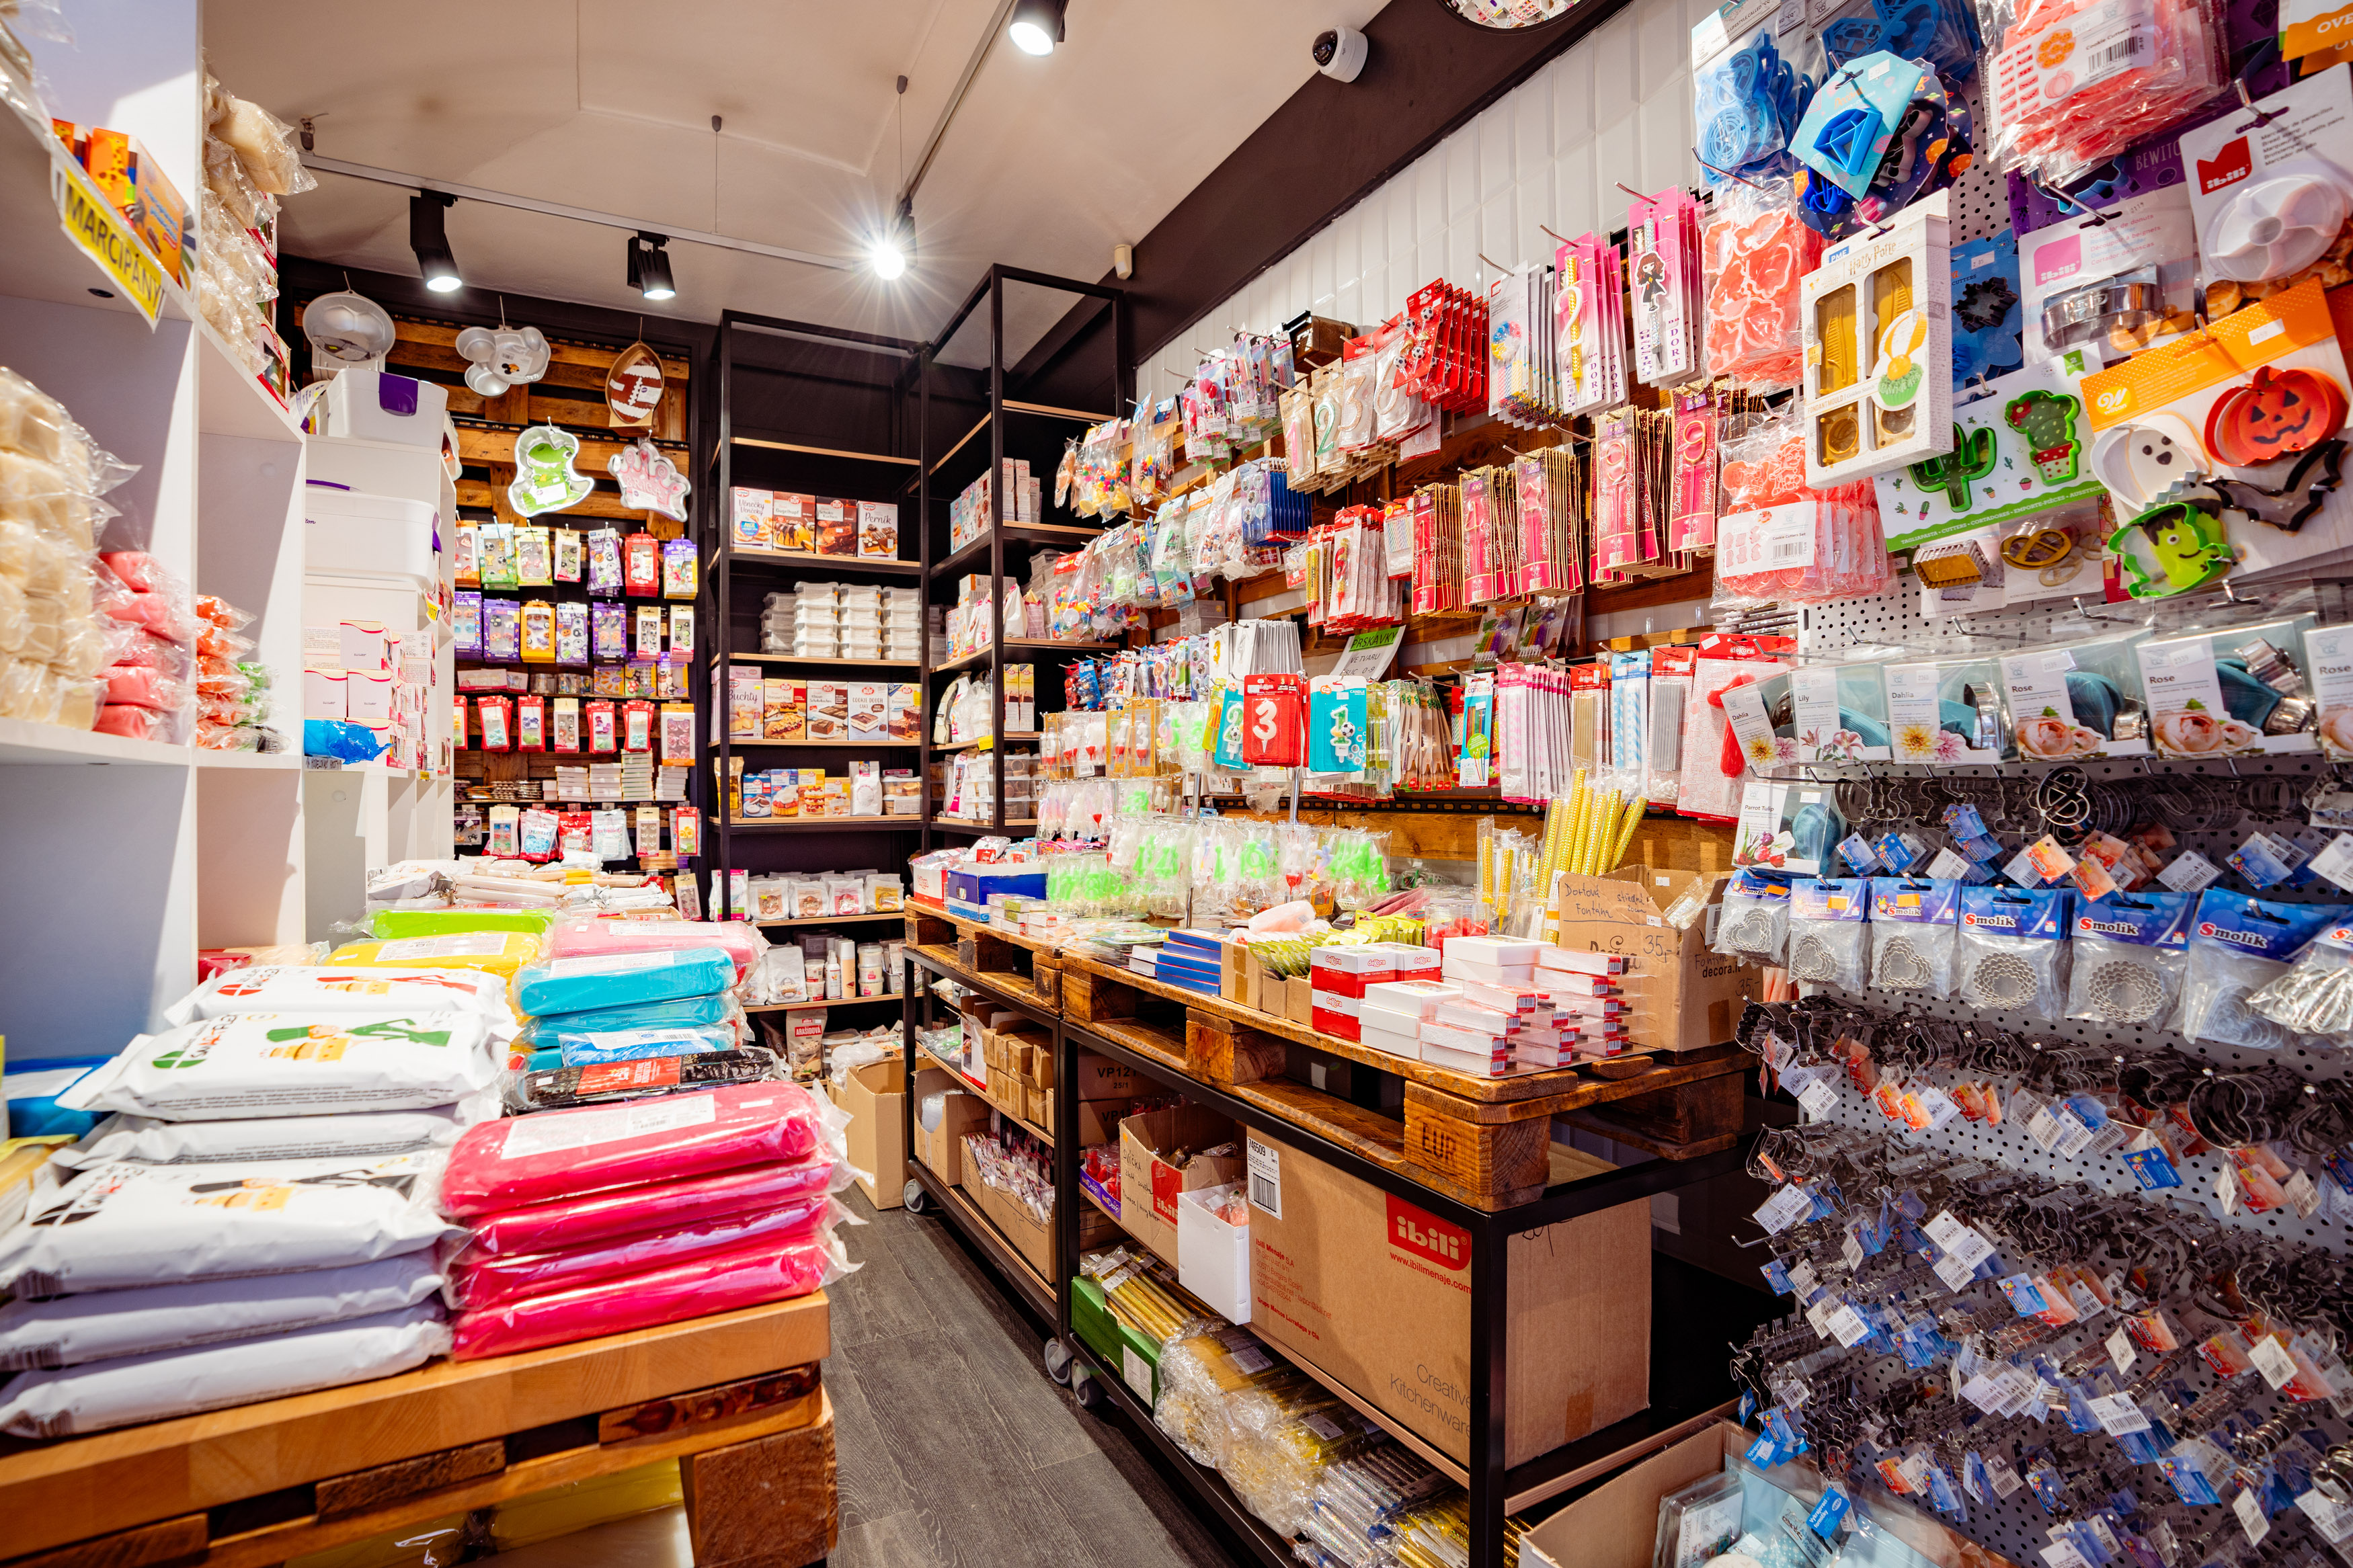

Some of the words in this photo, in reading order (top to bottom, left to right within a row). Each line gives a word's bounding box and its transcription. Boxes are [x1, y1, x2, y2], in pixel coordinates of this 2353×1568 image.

[1728, 17, 1749, 34] LIFESTYLE
[1747, 7, 1763, 20] CALLED
[2085, 41, 2104, 51] Cookie
[2104, 30, 2128, 45] Cutters
[2128, 22, 2141, 32] Set
[2206, 165, 2247, 191] ibili
[2089, 225, 2118, 239] Cortador
[2131, 214, 2155, 226] donuts
[65, 183, 163, 313] MARCIPÁNY
[1830, 249, 1848, 263] PME
[2090, 252, 2120, 265] Cortador
[2130, 241, 2155, 253] roscas
[1849, 250, 1874, 276] Harry
[2041, 262, 2077, 282] ibili
[1951, 274, 1977, 286] CUTTERS
[1670, 327, 1681, 367] DORT
[1589, 362, 1599, 398] DORT
[1807, 403, 1828, 415] FONDANT
[1827, 395, 1844, 407] MOULD
[865, 511, 892, 526] Perník
[1970, 511, 2011, 526] CORTADORES
[1350, 656, 1359, 664] VE
[1359, 653, 1380, 663] TVARU
[1361, 666, 1375, 674] 0-9
[2149, 673, 2176, 684] Rose
[2319, 663, 2352, 676] Rose
[1468, 685, 1490, 694] candles
[1798, 694, 1810, 703] Lily
[1891, 691, 1915, 699] Dahlia
[2011, 684, 2034, 693] Rose
[1731, 711, 1750, 721] Dahlia
[1745, 804, 1760, 812] Parrot
[1761, 804, 1774, 813] Tulip
[1564, 882, 1601, 898] Dortová
[1616, 893, 1646, 906] střední
[795, 1024, 822, 1036] ARAŠÍDOVÁ
[1113, 1081, 1129, 1089] 25/1
[1248, 1138, 1267, 1157] 746509
[1422, 1124, 1457, 1161] EUR
[1396, 1214, 1460, 1262] ibili
[1266, 1243, 1285, 1260] Menaje
[1389, 1251, 1472, 1294] www.ibilimenaje.com
[1257, 1296, 1270, 1309] Grupo
[1270, 1303, 1285, 1319] Marcos
[1416, 1363, 1471, 1411] Creative
[1390, 1372, 1471, 1440] Kitchenware
[1808, 1497, 1828, 1524] Vykrajovací
